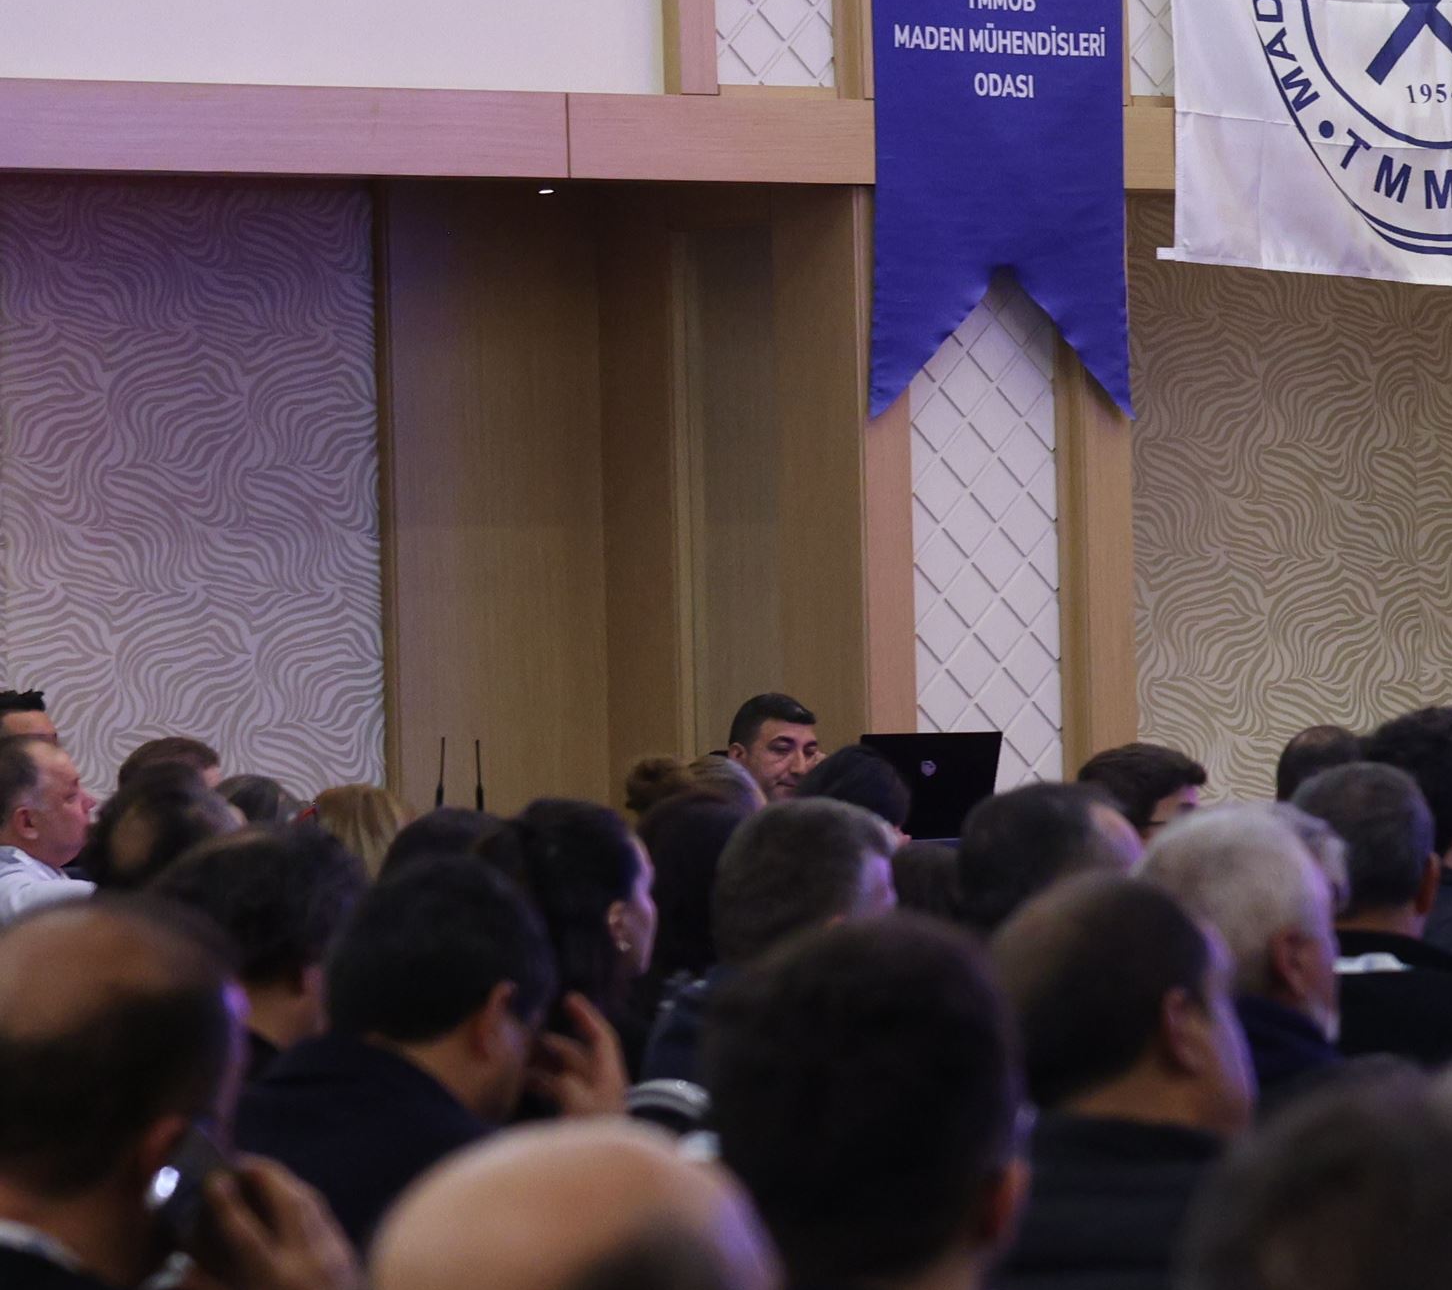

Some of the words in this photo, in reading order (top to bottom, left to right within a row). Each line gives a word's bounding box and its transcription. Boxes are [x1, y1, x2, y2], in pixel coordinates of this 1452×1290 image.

[894, 24, 964, 53] MADEN
[969, 23, 1106, 58] MÜHENDİSLERİ
[974, 72, 1034, 99] ODASI
